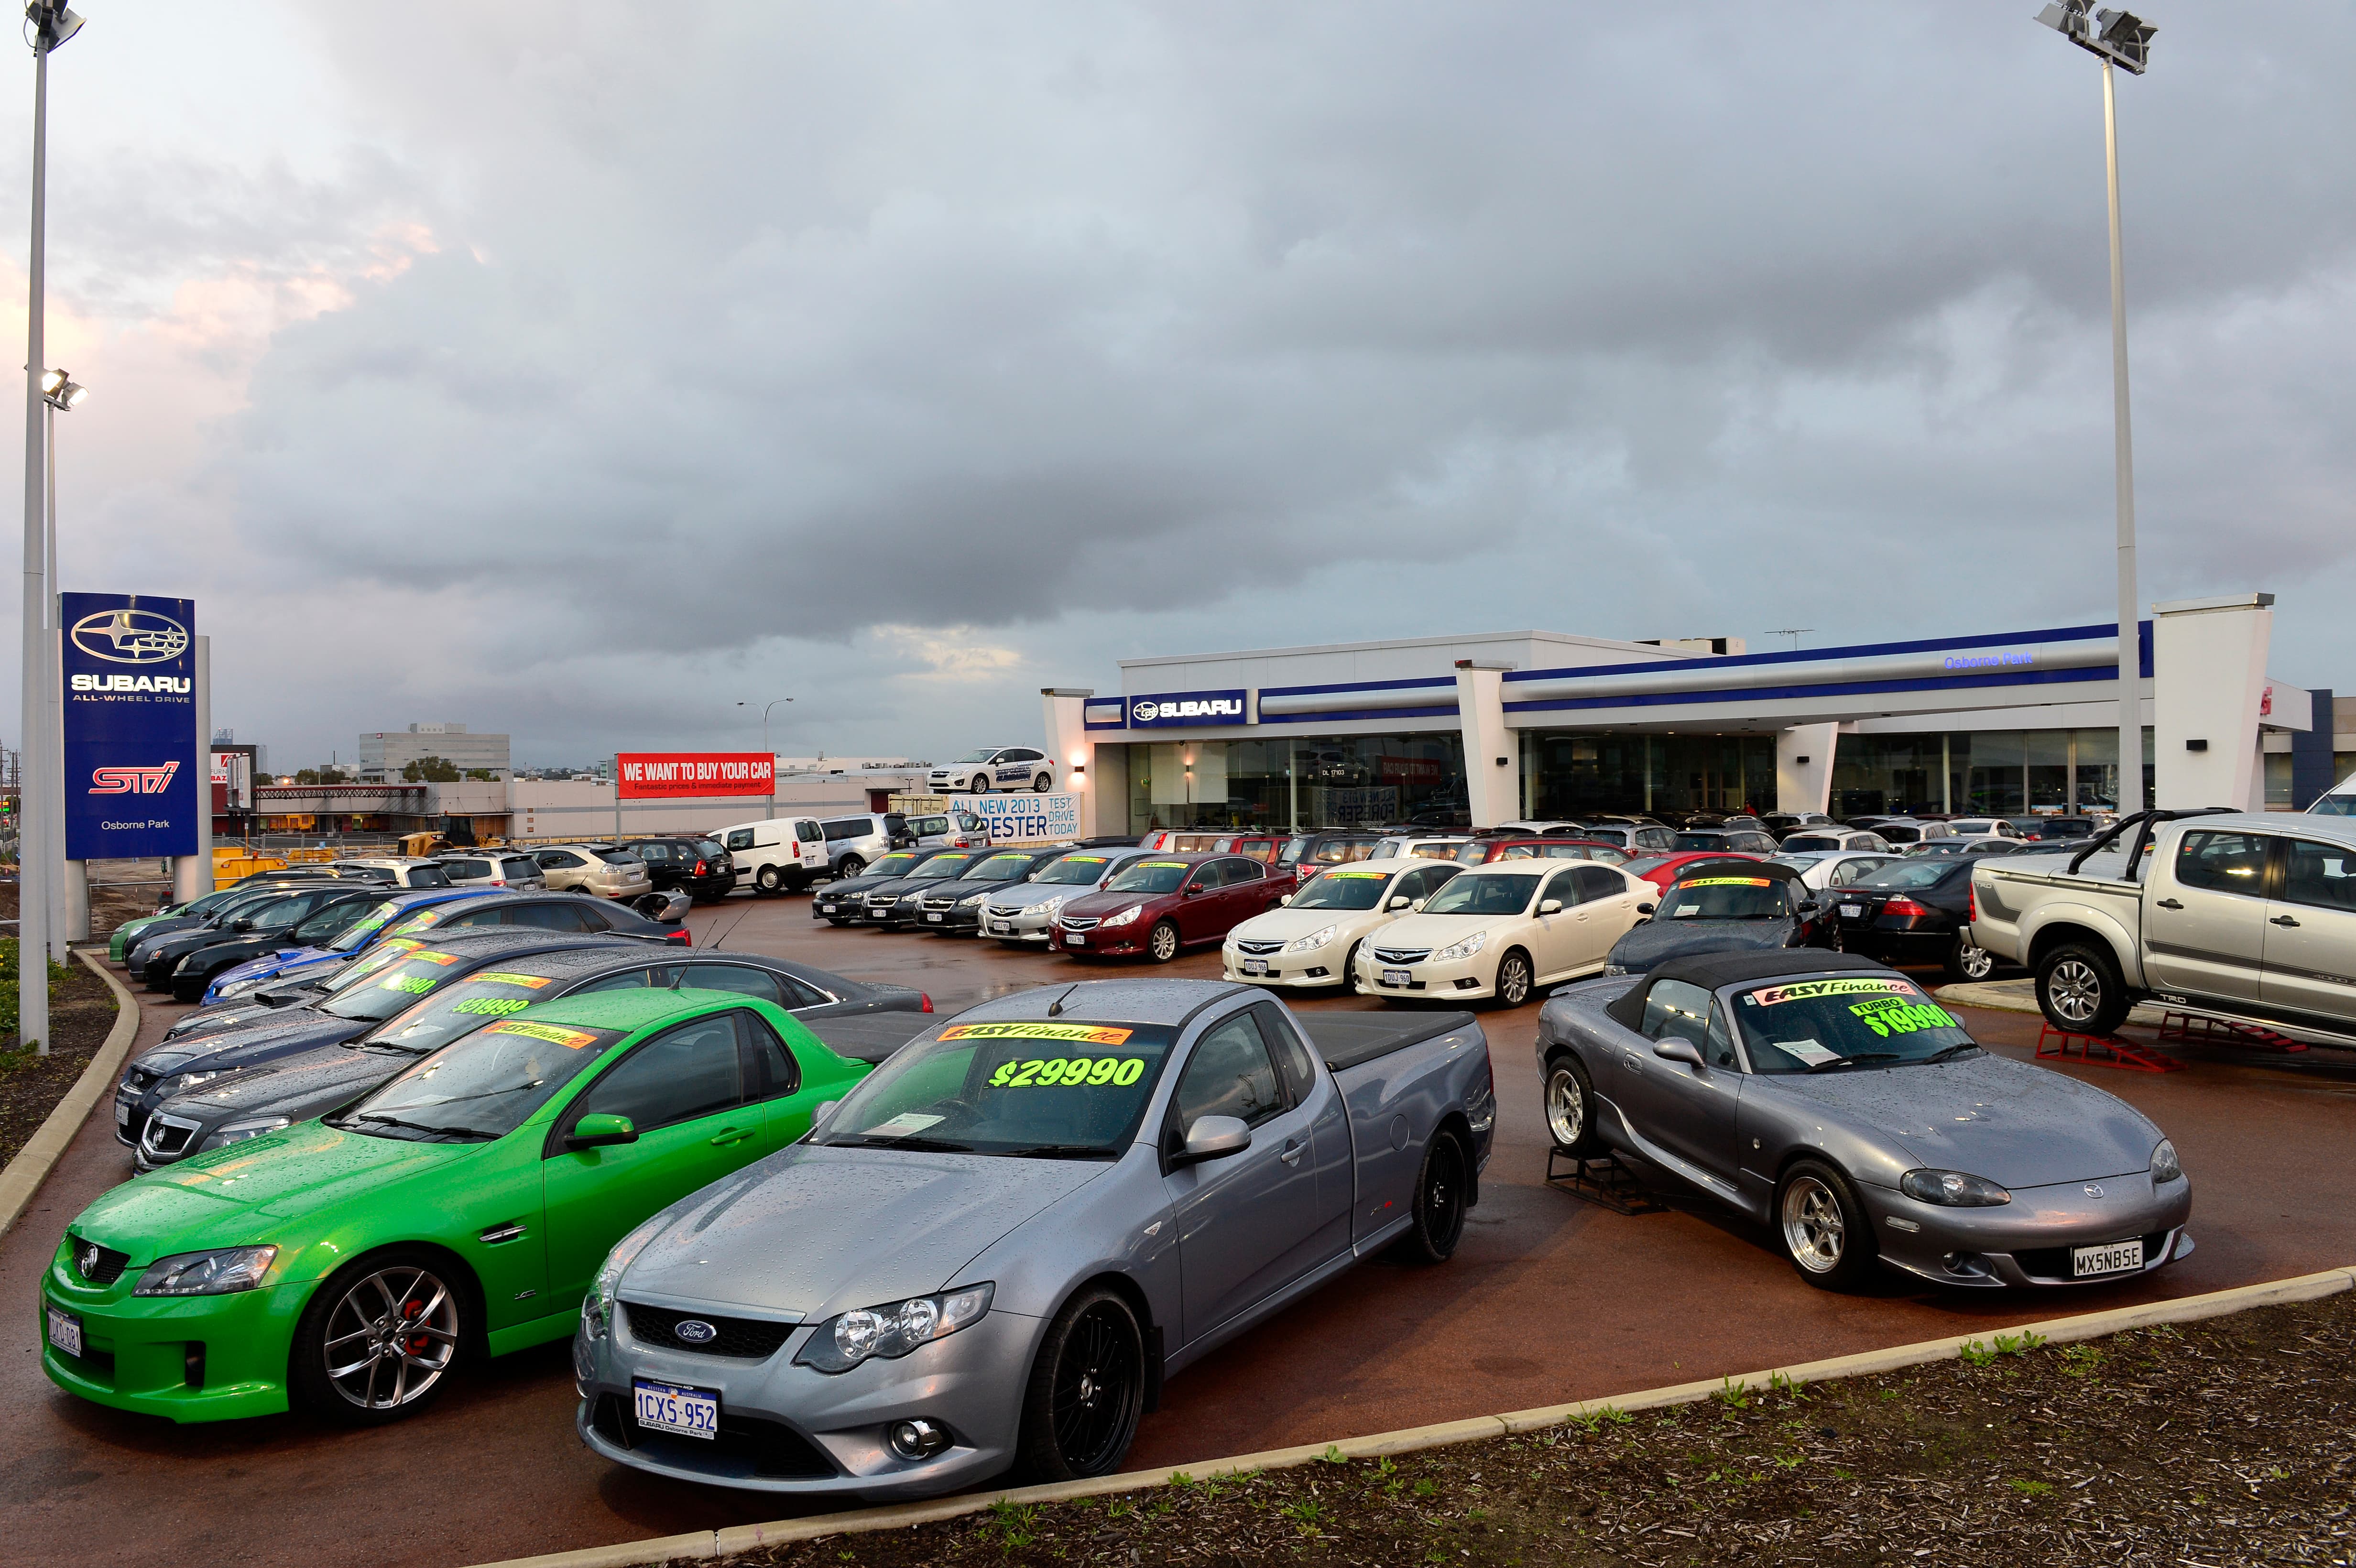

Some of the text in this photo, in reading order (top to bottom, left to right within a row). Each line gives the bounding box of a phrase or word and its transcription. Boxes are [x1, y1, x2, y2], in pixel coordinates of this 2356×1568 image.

[1944, 651, 2033, 669] Osborne Park
[71, 674, 190, 693] SUBARU
[1159, 699, 1242, 717] SUBARU
[623, 762, 771, 781] WE WANT TO BUY YOUR CAR
[669, 783, 689, 791] prices
[734, 782, 761, 790] payment
[980, 799, 1007, 814] NEW
[1011, 799, 1040, 813] 2013
[1049, 798, 1071, 808] TEST
[1049, 811, 1074, 822] DRIVE
[101, 820, 170, 829] Osborne Park
[1049, 823, 1078, 835] TODAY
[1855, 999, 1900, 1013] TURBO
[1864, 1004, 1956, 1038] $19990
[988, 1058, 1145, 1087] $29990
[2077, 1247, 2139, 1274] MX5NBSE
[683, 1323, 706, 1338] Ford
[640, 1420, 664, 1429] SUBARU
[665, 1426, 688, 1434] Osborne
